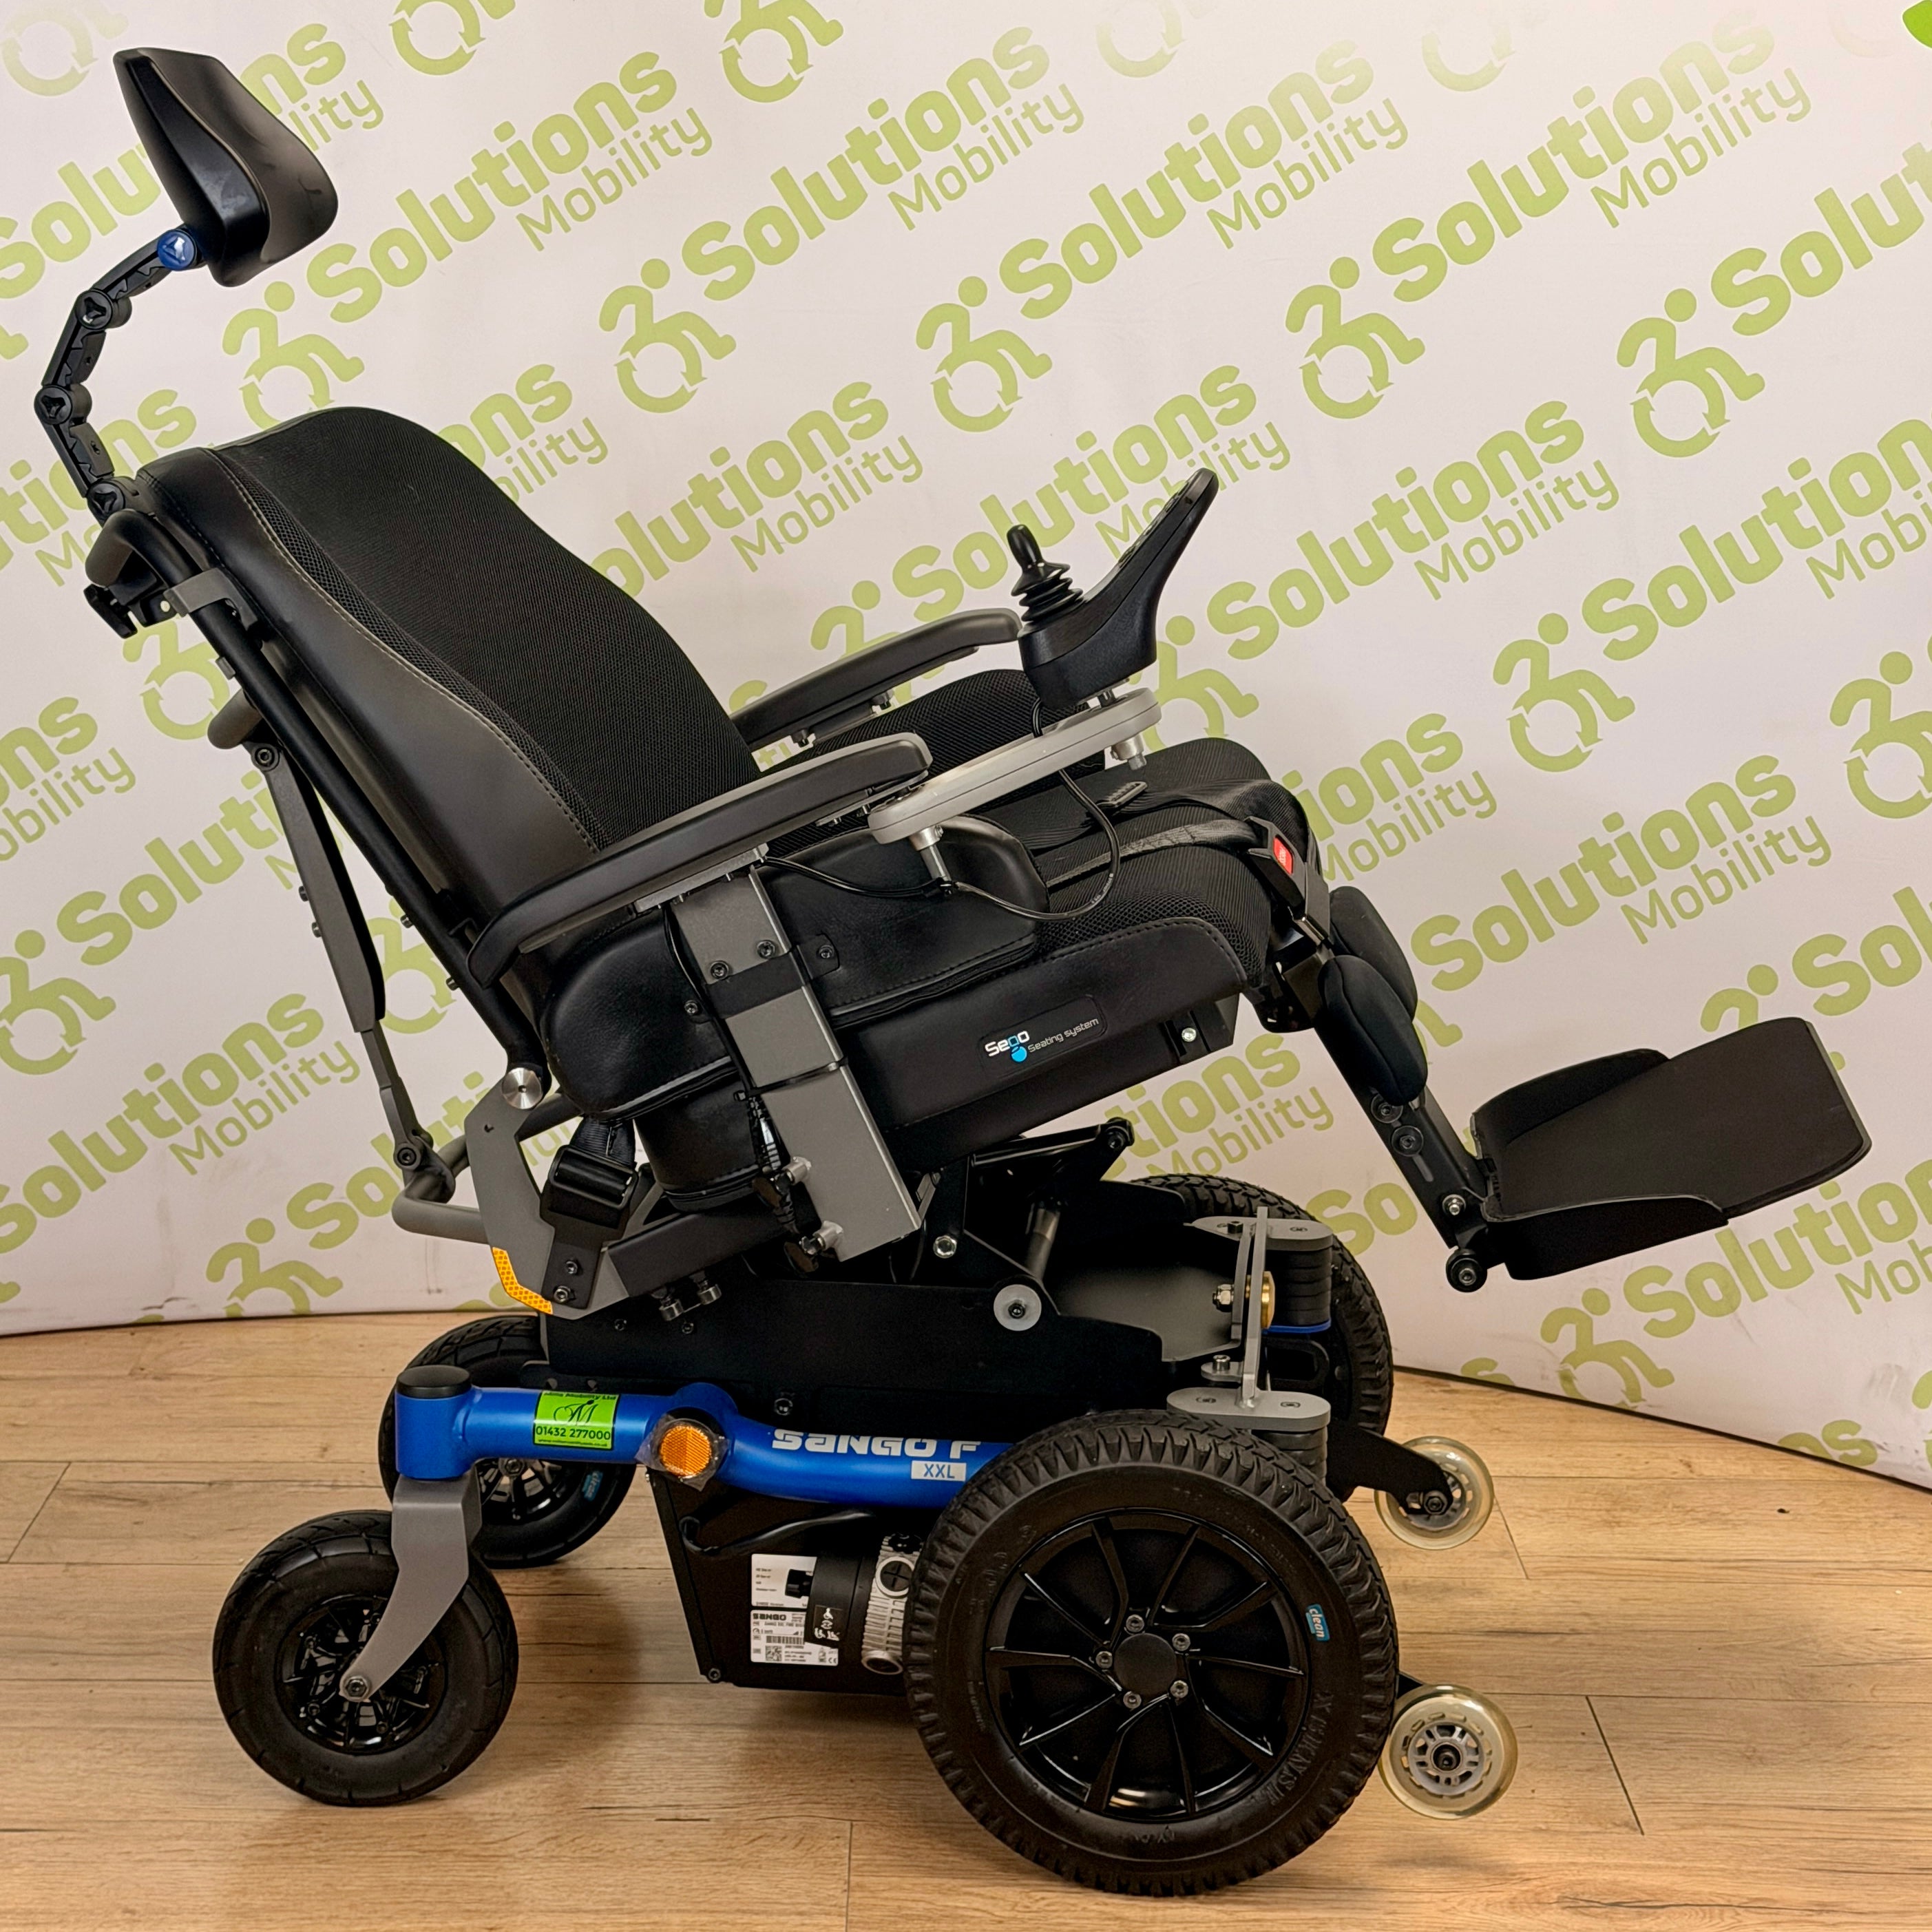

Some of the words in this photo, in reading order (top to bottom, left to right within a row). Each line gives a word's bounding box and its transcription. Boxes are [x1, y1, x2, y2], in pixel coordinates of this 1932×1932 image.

[304, 50, 678, 324] Solutions
[514, 106, 713, 252] Mobility
[679, 26, 1049, 302] Solutions
[885, 83, 1084, 231] Mobility
[997, 43, 1374, 321] Solutions
[1205, 98, 1409, 250] Mobility
[1369, 8, 1774, 304] Solutions
[1588, 69, 1812, 229] Mobility
[588, 380, 889, 600] olutions
[728, 434, 923, 574] Mobility
[890, 364, 1258, 625] Solutions
[1204, 399, 1585, 662] Solutions
[1413, 459, 1621, 601] Mobility
[1408, 754, 1797, 993] Solutions
[1619, 815, 1832, 946] Mobility
[167, 1040, 361, 1176] Mobility
[1027, 1033, 1064, 1053] Seating
[1063, 1018, 1100, 1037] system
[536, 1425, 567, 1437] 01432
[569, 1428, 611, 1440] 277000
[923, 1463, 956, 1479] XXL
[949, 1440, 981, 1460] F
[1309, 1608, 1325, 1638] clean
